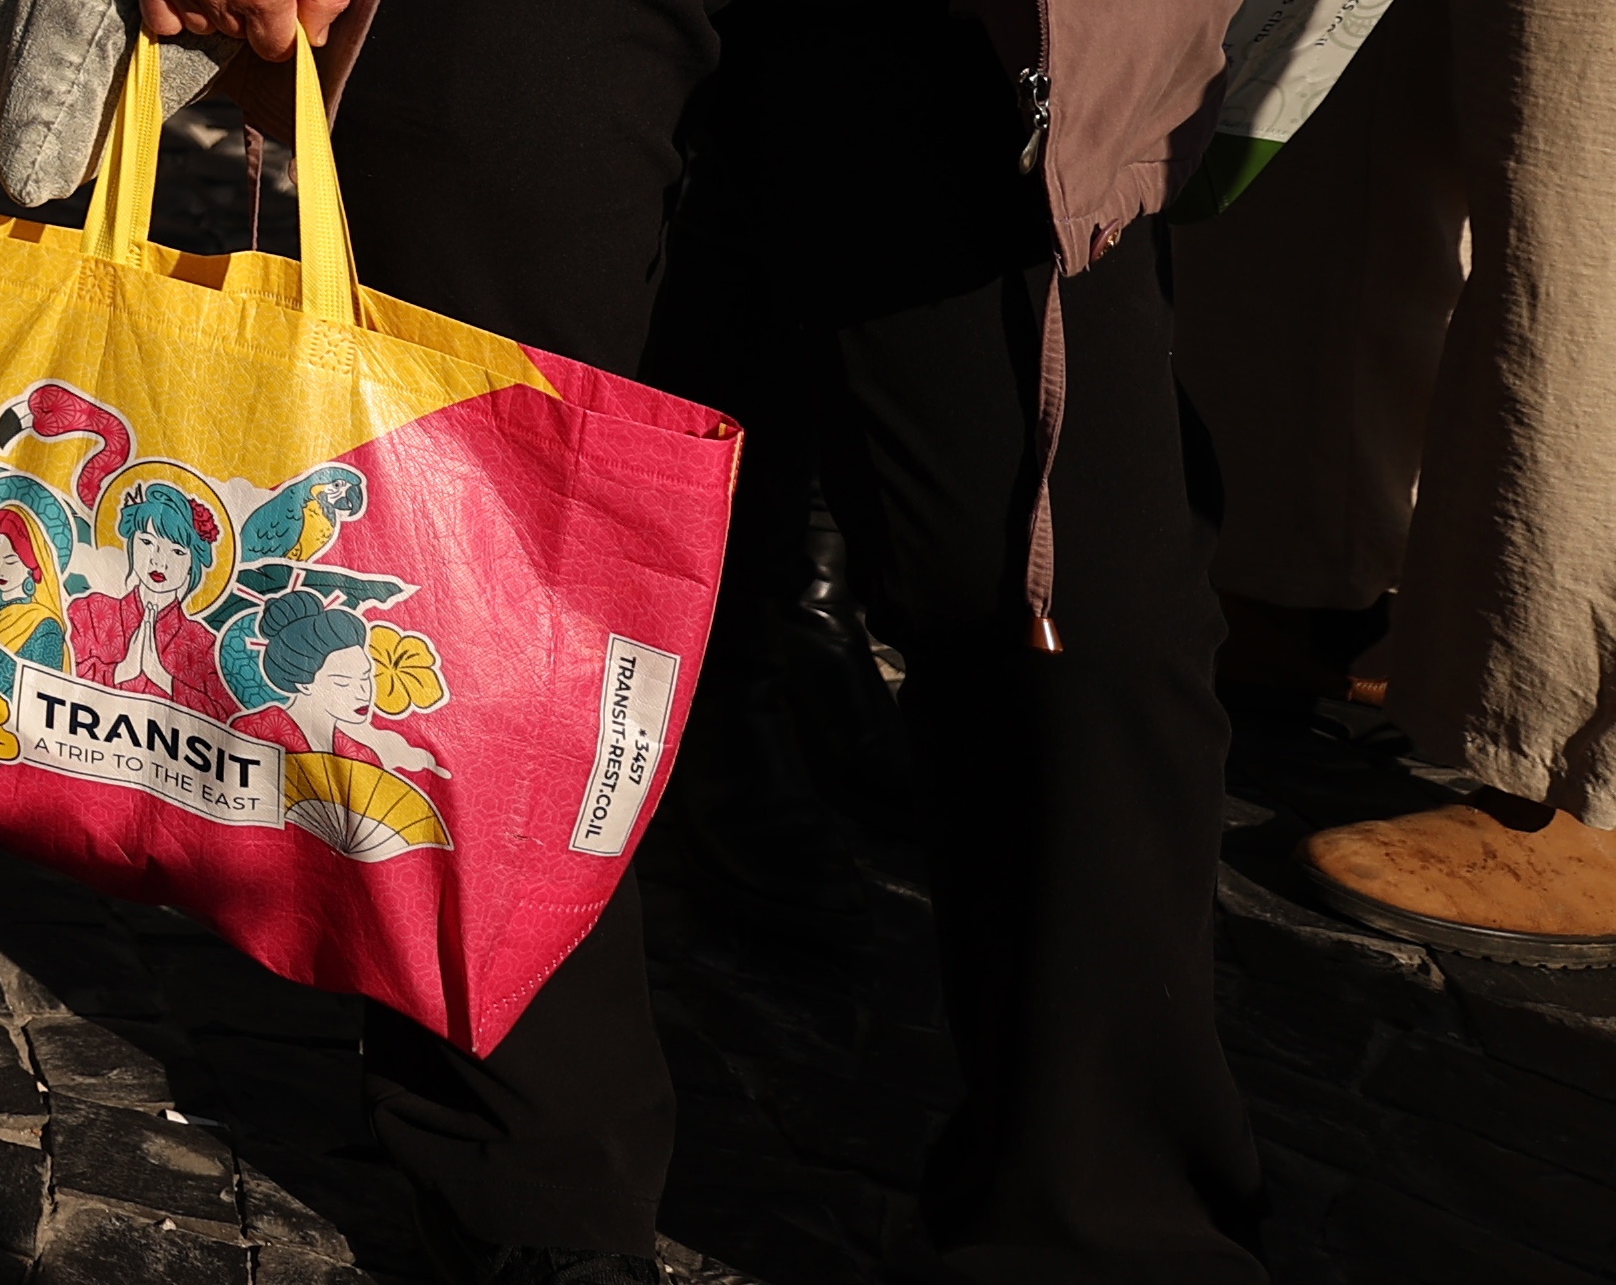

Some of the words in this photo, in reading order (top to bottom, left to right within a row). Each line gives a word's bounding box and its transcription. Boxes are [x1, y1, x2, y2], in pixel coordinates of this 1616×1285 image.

[1254, 10, 1283, 43] club
[34, 737, 50, 754] A
[55, 741, 105, 764] TRIP
[113, 753, 144, 772] TO
[151, 761, 194, 793] THE
[201, 784, 261, 811] EAST
[36, 691, 261, 789] TRANSIT
[584, 655, 637, 839] TRANSIT-REST.CO.IL
